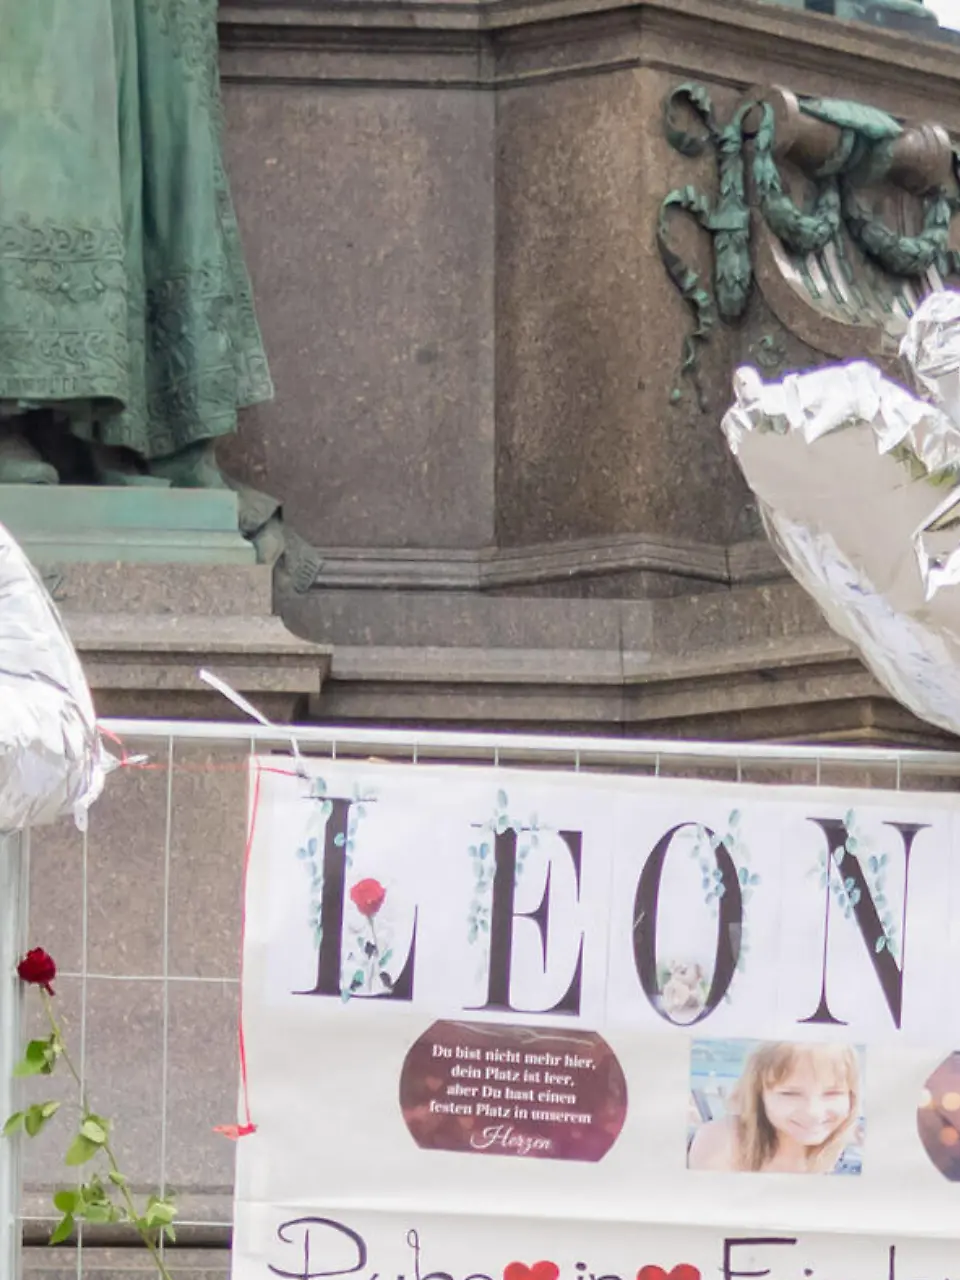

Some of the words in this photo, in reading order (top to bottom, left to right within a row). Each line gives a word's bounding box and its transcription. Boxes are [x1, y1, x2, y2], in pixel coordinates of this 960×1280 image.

[432, 1044, 452, 1058] Du
[455, 1046, 481, 1060] bist
[485, 1048, 520, 1063] nicht
[524, 1051, 561, 1066] mehr
[564, 1054, 597, 1070] hier,
[451, 1064, 481, 1079] dein
[485, 1066, 520, 1081] Platz
[523, 1068, 540, 1082] ist
[544, 1070, 575, 1087] leer,
[446, 1084, 478, 1098] aber
[481, 1085, 501, 1098] Du
[504, 1086, 534, 1101] hast
[537, 1089, 576, 1104] einen
[429, 1100, 473, 1115] festen
[475, 1102, 510, 1117] Platz
[514, 1105, 528, 1119] in
[531, 1109, 593, 1124] unserem
[470, 1124, 552, 1155] Herzen
